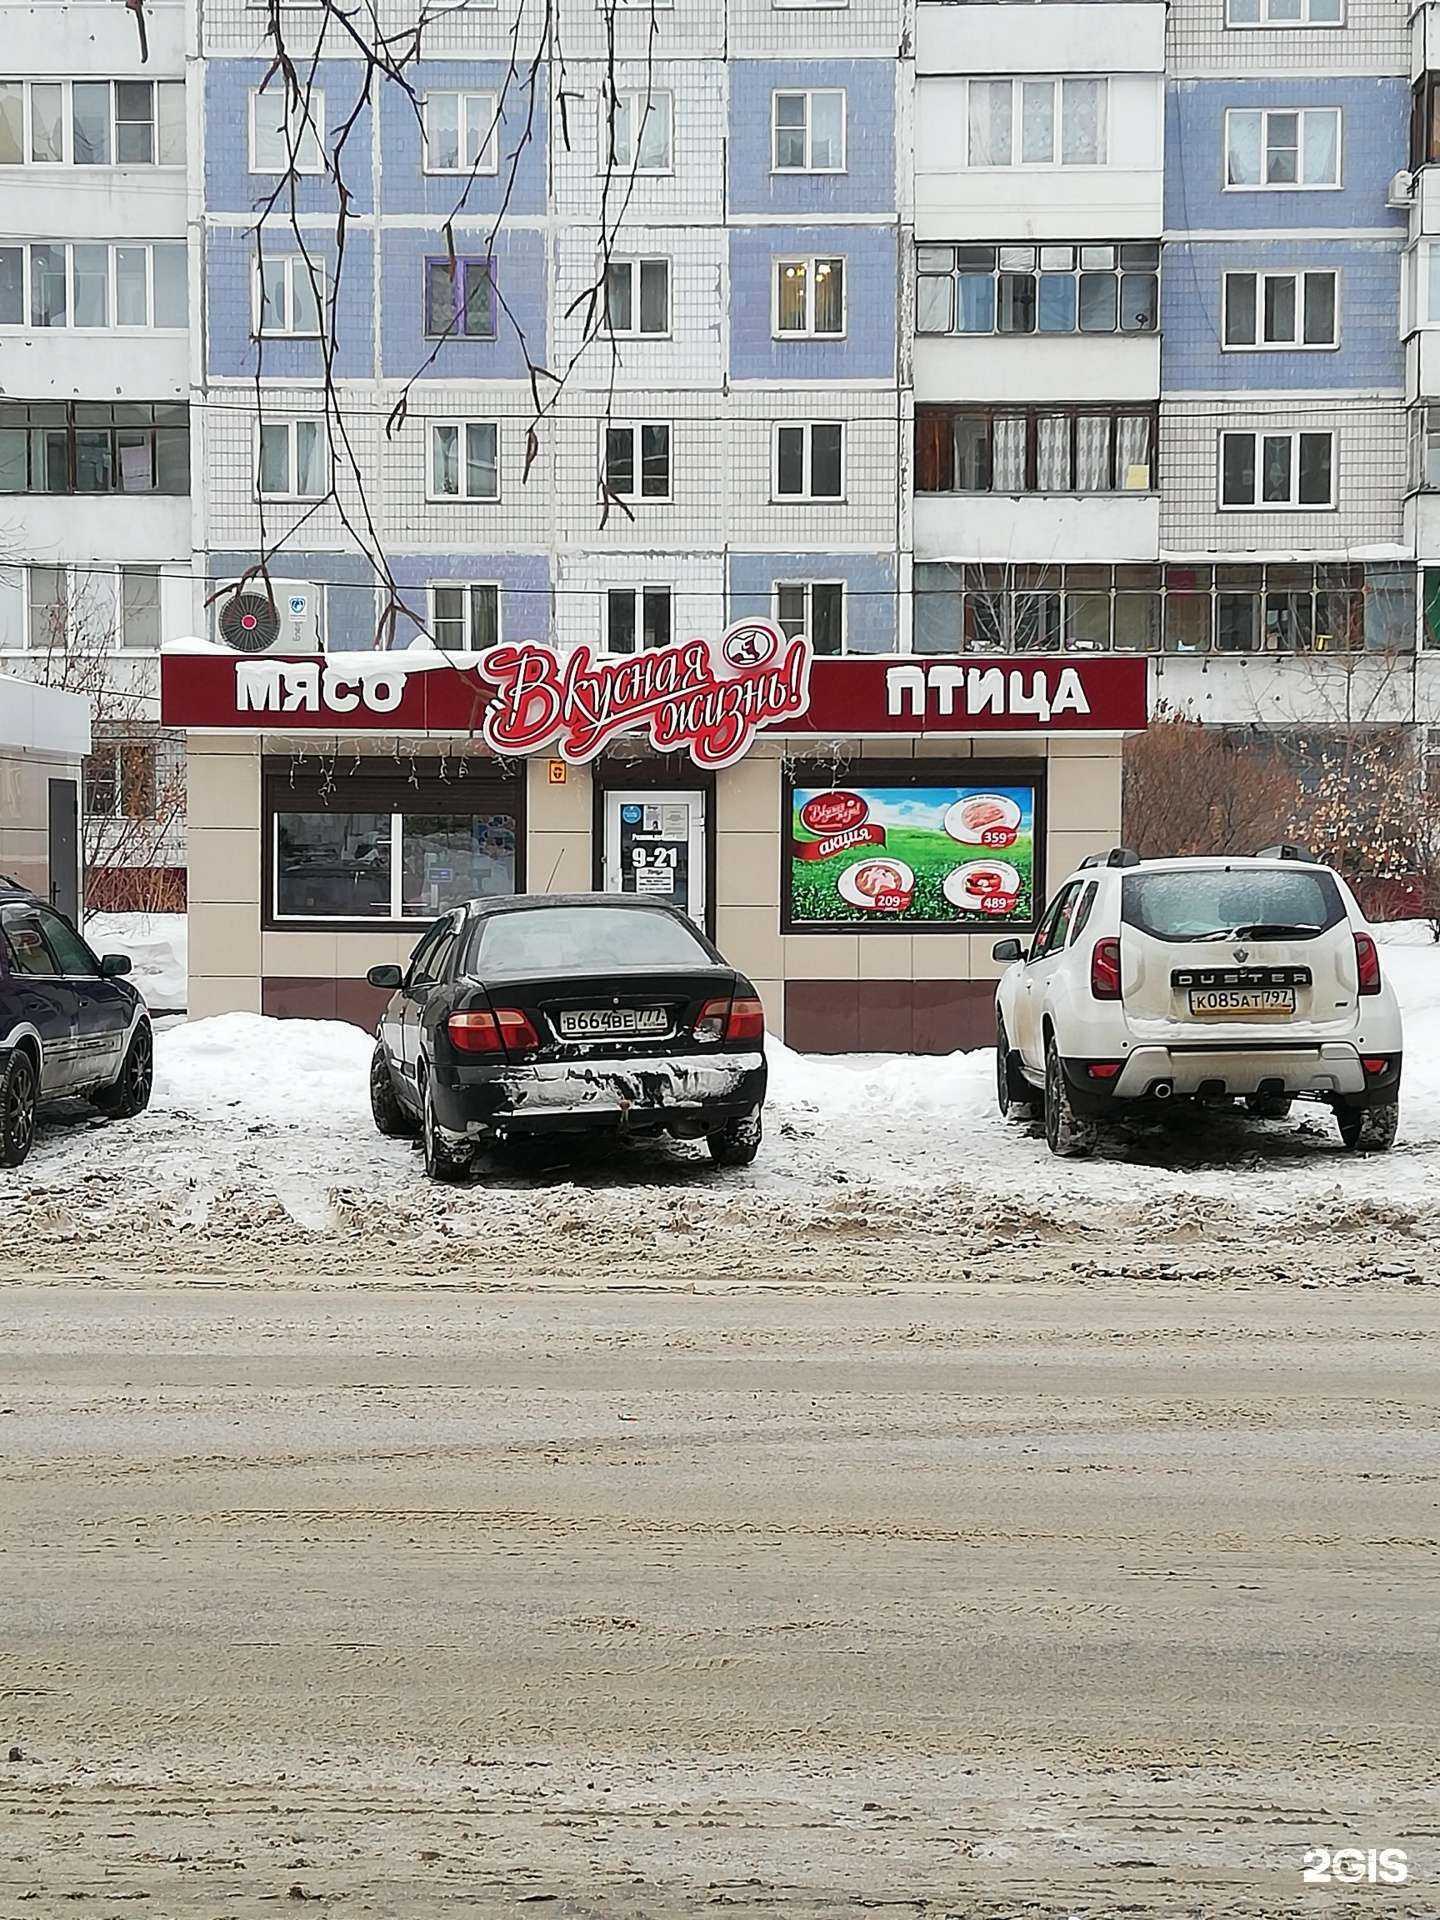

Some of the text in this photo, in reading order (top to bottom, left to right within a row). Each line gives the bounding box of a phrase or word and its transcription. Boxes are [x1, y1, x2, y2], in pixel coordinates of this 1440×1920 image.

[485, 645, 710, 751] Вкусная
[886, 666, 1091, 722] ПТИЦА
[818, 827, 873, 856] акция
[983, 831, 1007, 844] 359
[632, 847, 677, 868] 9-21
[877, 895, 901, 907] 209
[983, 897, 1007, 909] 489
[1178, 973, 1307, 985] DUSTER
